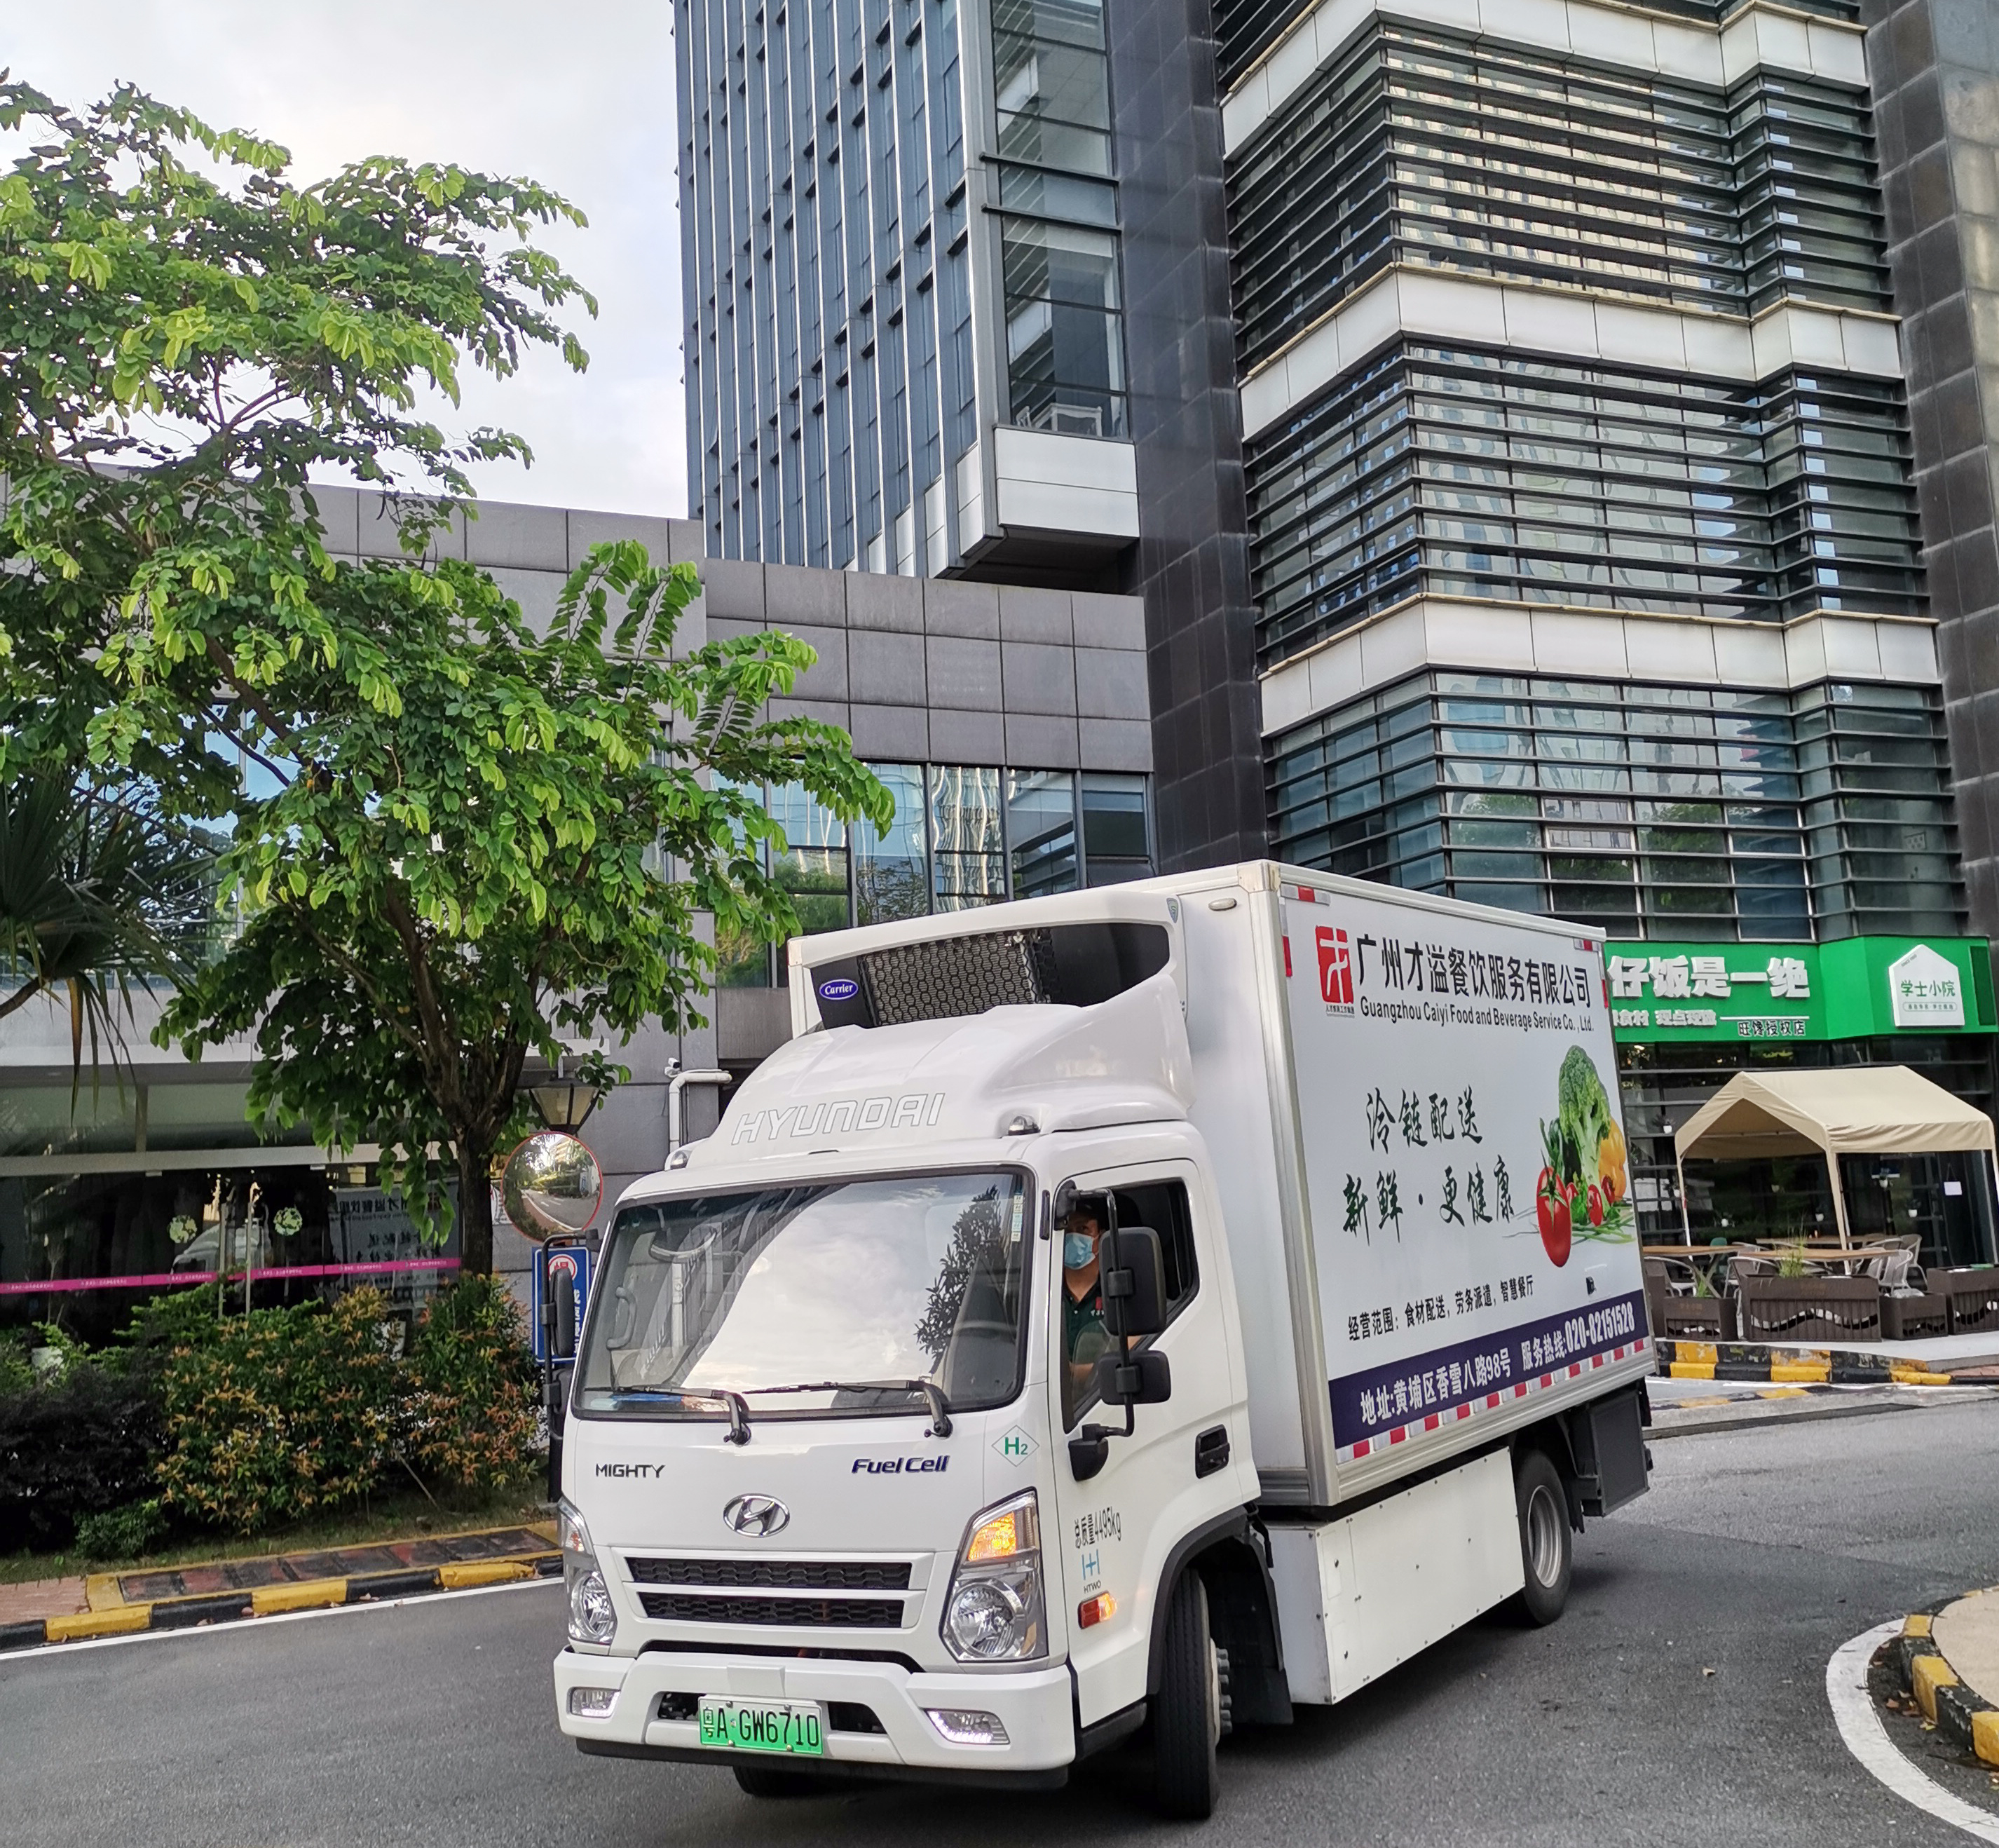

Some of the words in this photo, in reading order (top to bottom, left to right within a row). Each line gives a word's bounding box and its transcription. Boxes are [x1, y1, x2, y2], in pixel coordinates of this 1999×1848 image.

[1357, 934, 1591, 1008] 广州才溢餐饮服务有限公司
[1608, 954, 1811, 999] 仔饭是一绝
[825, 984, 853, 996] Carrier
[1901, 979, 1956, 998] 学士小院
[1360, 996, 1421, 1024] Guangzhou
[1424, 1001, 1449, 1027] Caiyi
[1450, 1004, 1473, 1024] Food
[1475, 1007, 1492, 1026] and
[1493, 1008, 1532, 1033] Beverage
[1534, 1011, 1562, 1030] Service
[731, 1092, 946, 1146] HYUNDAI
[1366, 1085, 1483, 1155] 冷链配送
[596, 1463, 666, 1479] MIGHTY
[852, 1458, 904, 1474] Fuel
[905, 1455, 950, 1472] Cell
[1084, 1579, 1101, 1594] HTWO
